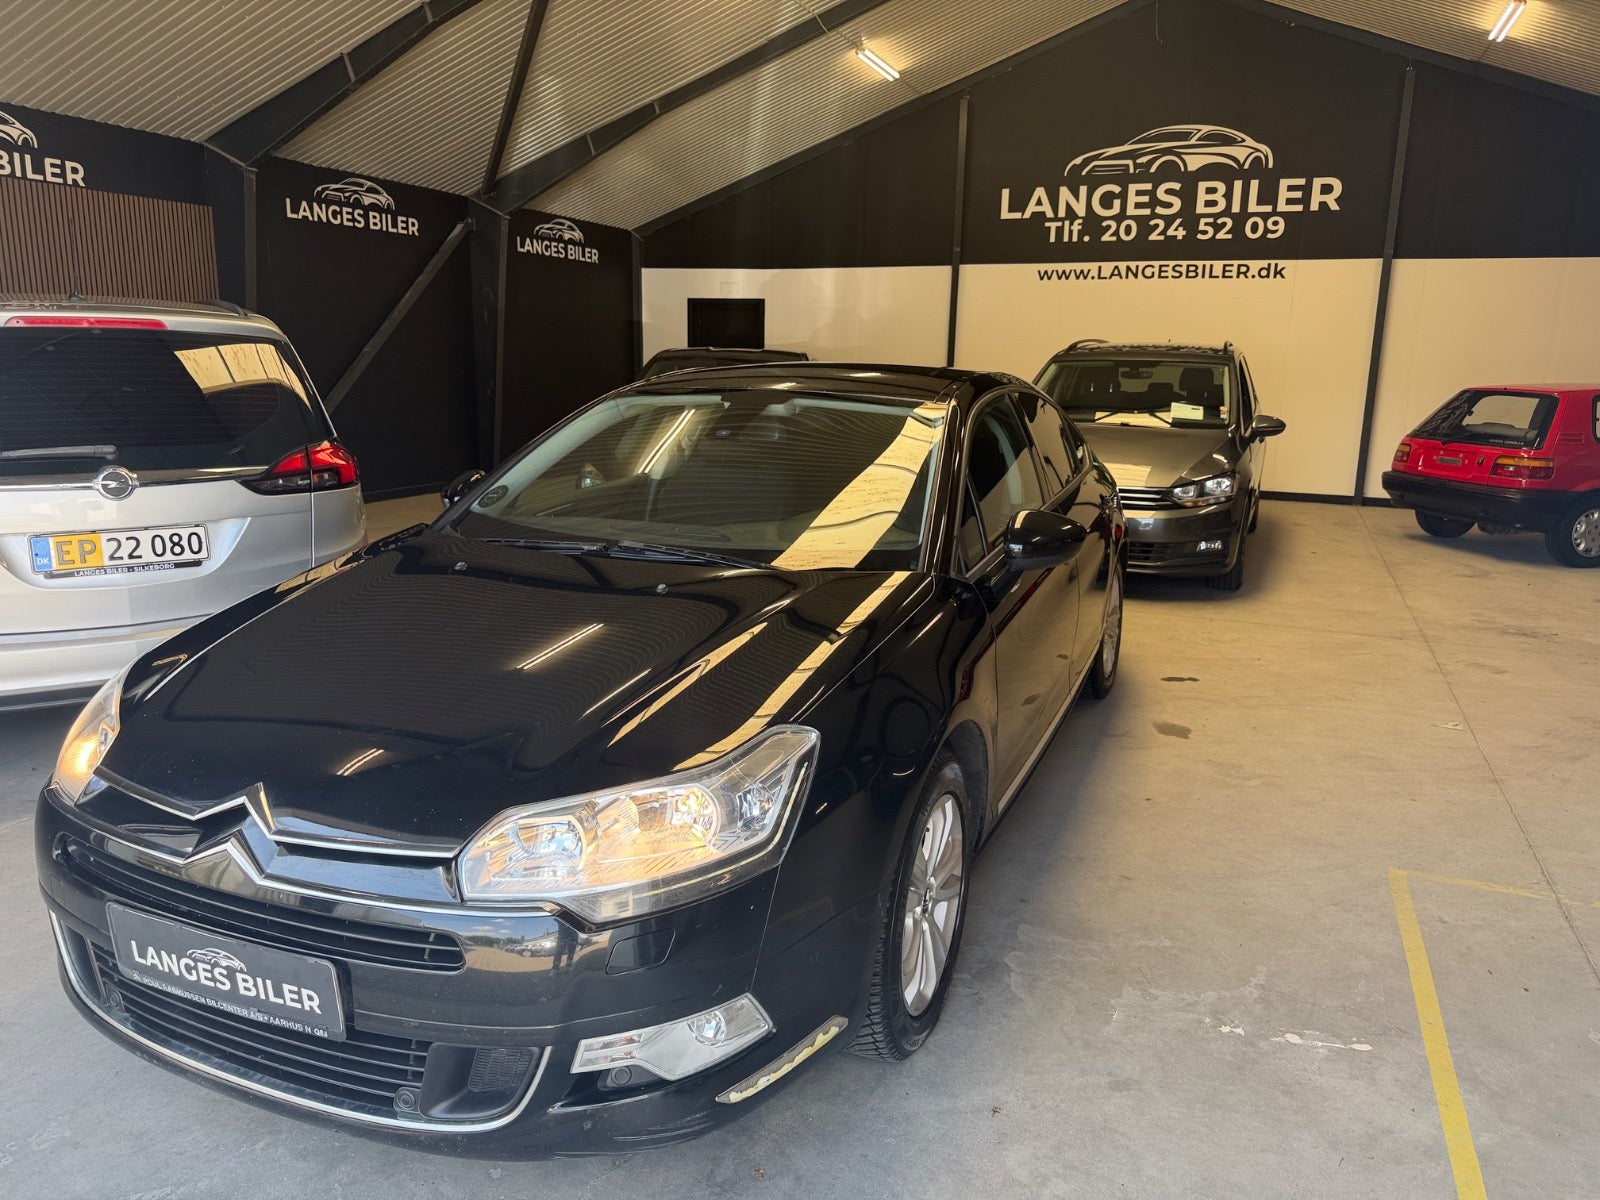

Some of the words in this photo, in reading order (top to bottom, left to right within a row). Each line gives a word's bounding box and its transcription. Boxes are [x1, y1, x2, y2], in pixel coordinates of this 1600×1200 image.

[1000, 181, 1182, 220] LANGES
[1195, 177, 1343, 215] BILER
[285, 197, 365, 228] LANGES
[368, 211, 419, 236] BILER
[1044, 219, 1090, 243] Tlf.
[1100, 219, 1138, 242] 20
[1148, 218, 1187, 241] 24
[1196, 217, 1233, 240] 52
[1244, 216, 1286, 239] 09
[516, 235, 566, 258] LANGES
[567, 244, 599, 264] BILER
[1037, 263, 1286, 281] www.LANGESBILER.dk
[37, 557, 50, 566] DK
[55, 539, 97, 565] EP
[105, 536, 143, 562] 22
[151, 531, 204, 558] 080
[74, 568, 105, 577] LANGES
[106, 567, 129, 575] BILER
[133, 563, 175, 573] SILKEBORG
[130, 940, 231, 991] LANGES
[237, 972, 322, 1014] BILER
[206, 998, 248, 1018] BILCENTER
[249, 1010, 263, 1021] A/S
[270, 1017, 303, 1032] AARHUS
